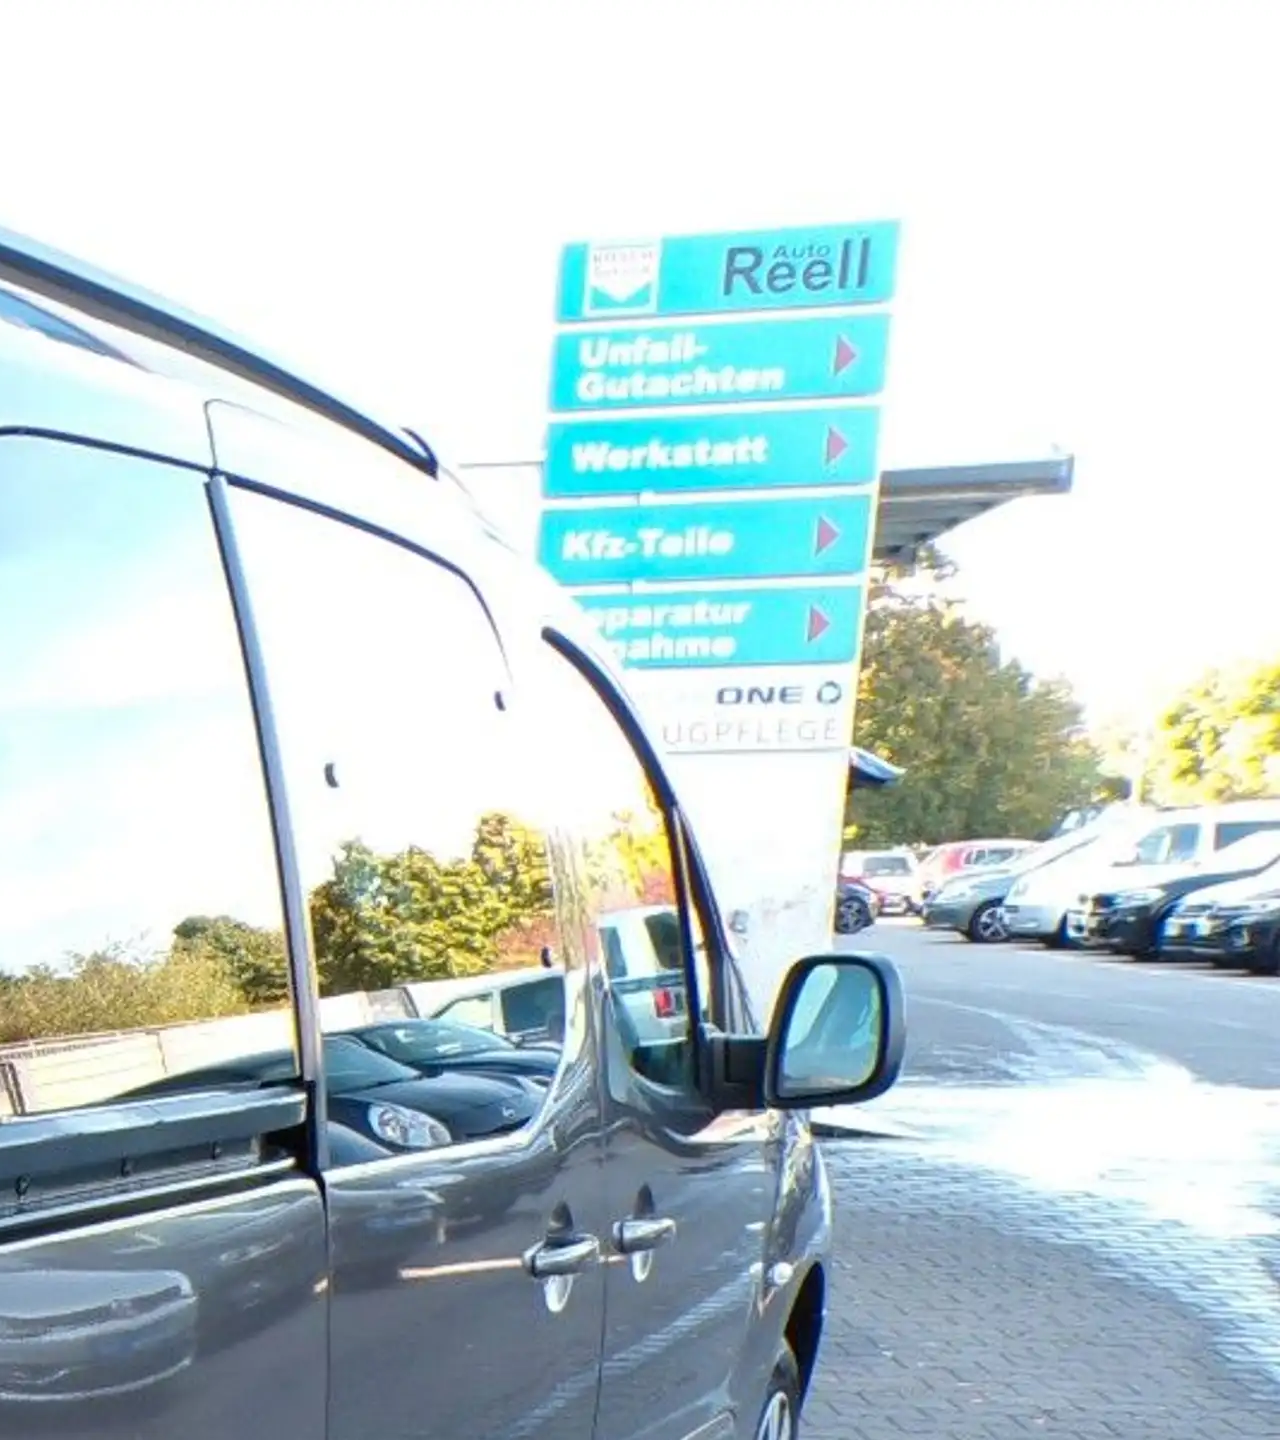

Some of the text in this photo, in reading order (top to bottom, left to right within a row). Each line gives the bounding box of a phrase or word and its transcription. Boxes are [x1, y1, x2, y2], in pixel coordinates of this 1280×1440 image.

[723, 238, 871, 296] Reell
[772, 244, 831, 259] Auto
[579, 333, 709, 368] Unfall-
[576, 364, 785, 401] Gutachten
[571, 435, 769, 473] Werkstatt
[561, 526, 735, 562] Kfz-Teile
